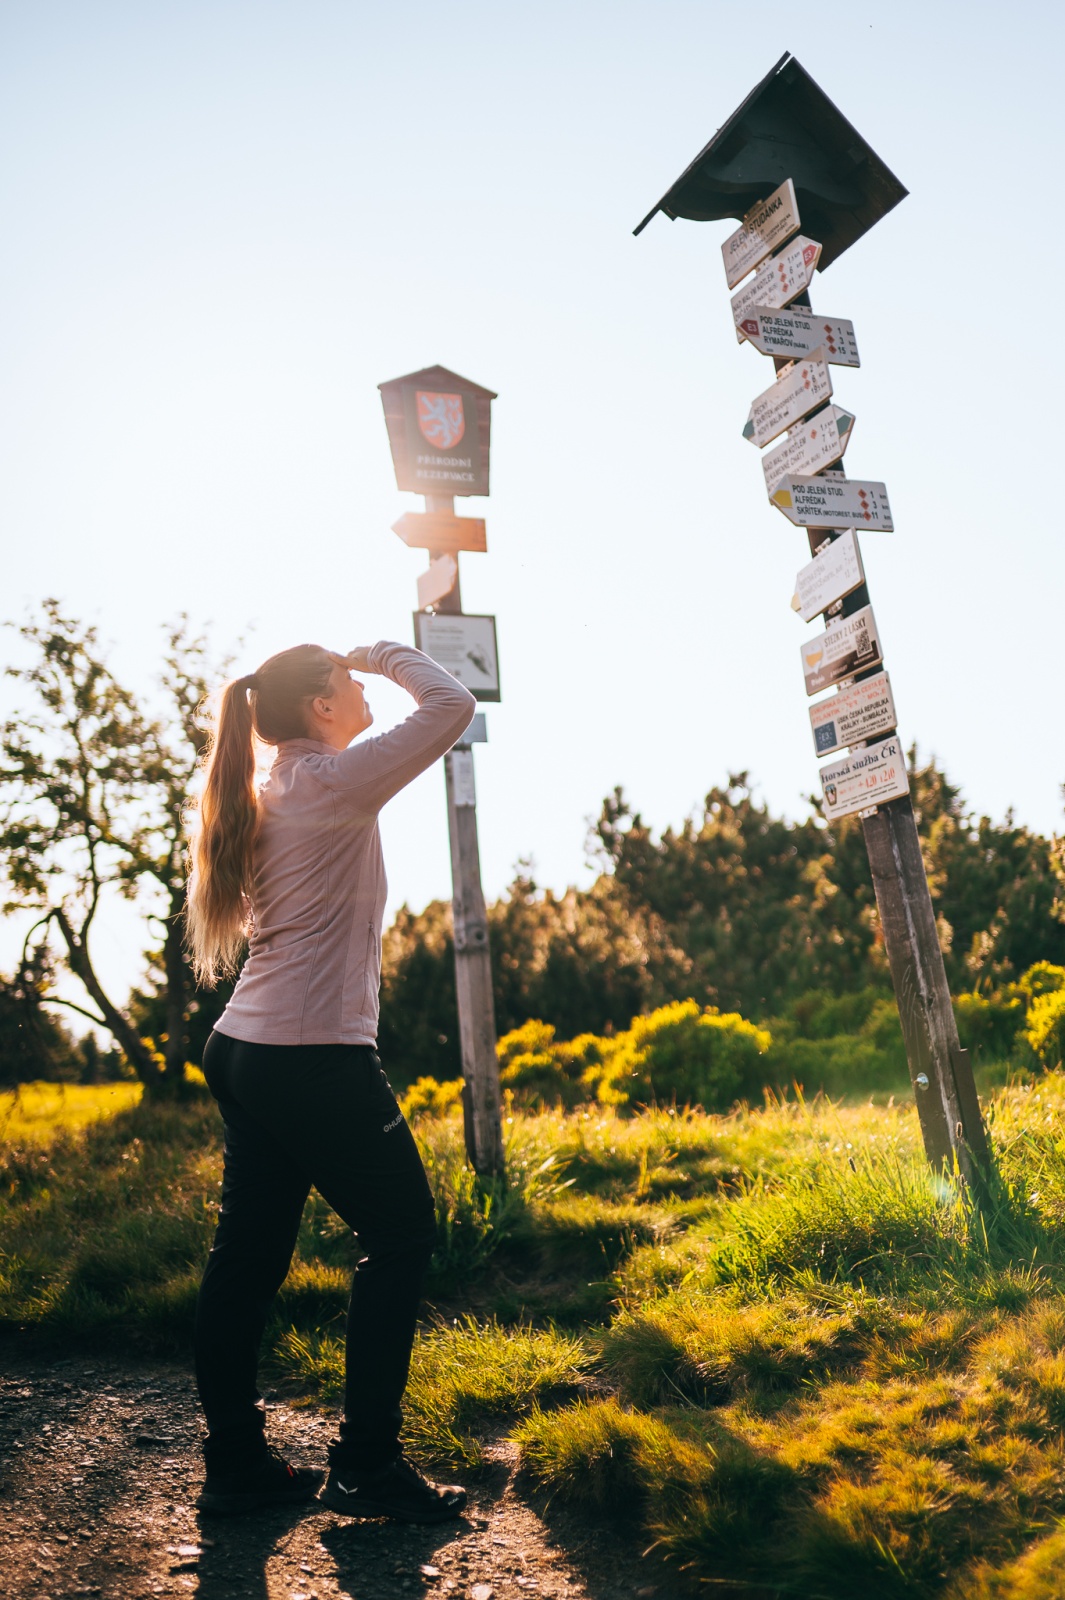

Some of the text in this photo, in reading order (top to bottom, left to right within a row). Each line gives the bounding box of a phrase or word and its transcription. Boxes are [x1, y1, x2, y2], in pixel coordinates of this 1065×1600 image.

[748, 324, 757, 332] E3
[760, 316, 772, 325] POD
[774, 318, 794, 328] JELENÍ
[838, 327, 842, 335] 1
[838, 346, 846, 354] 15
[416, 469, 475, 482] REZERVACE
[792, 484, 806, 494] POD
[807, 485, 827, 494] JELENÍ
[828, 487, 845, 496] STUD.
[870, 490, 874, 498] 1
[795, 495, 827, 506] ALFRÉDKA
[872, 500, 878, 509] 3
[872, 511, 878, 519] 11
[849, 708, 864, 719] ČESKÁ
[864, 698, 889, 712] REPUBLIKA
[862, 707, 888, 722] BUMBÁLKA
[820, 764, 850, 784] Horská
[852, 755, 879, 770] služba
[881, 743, 896, 758] ČR
